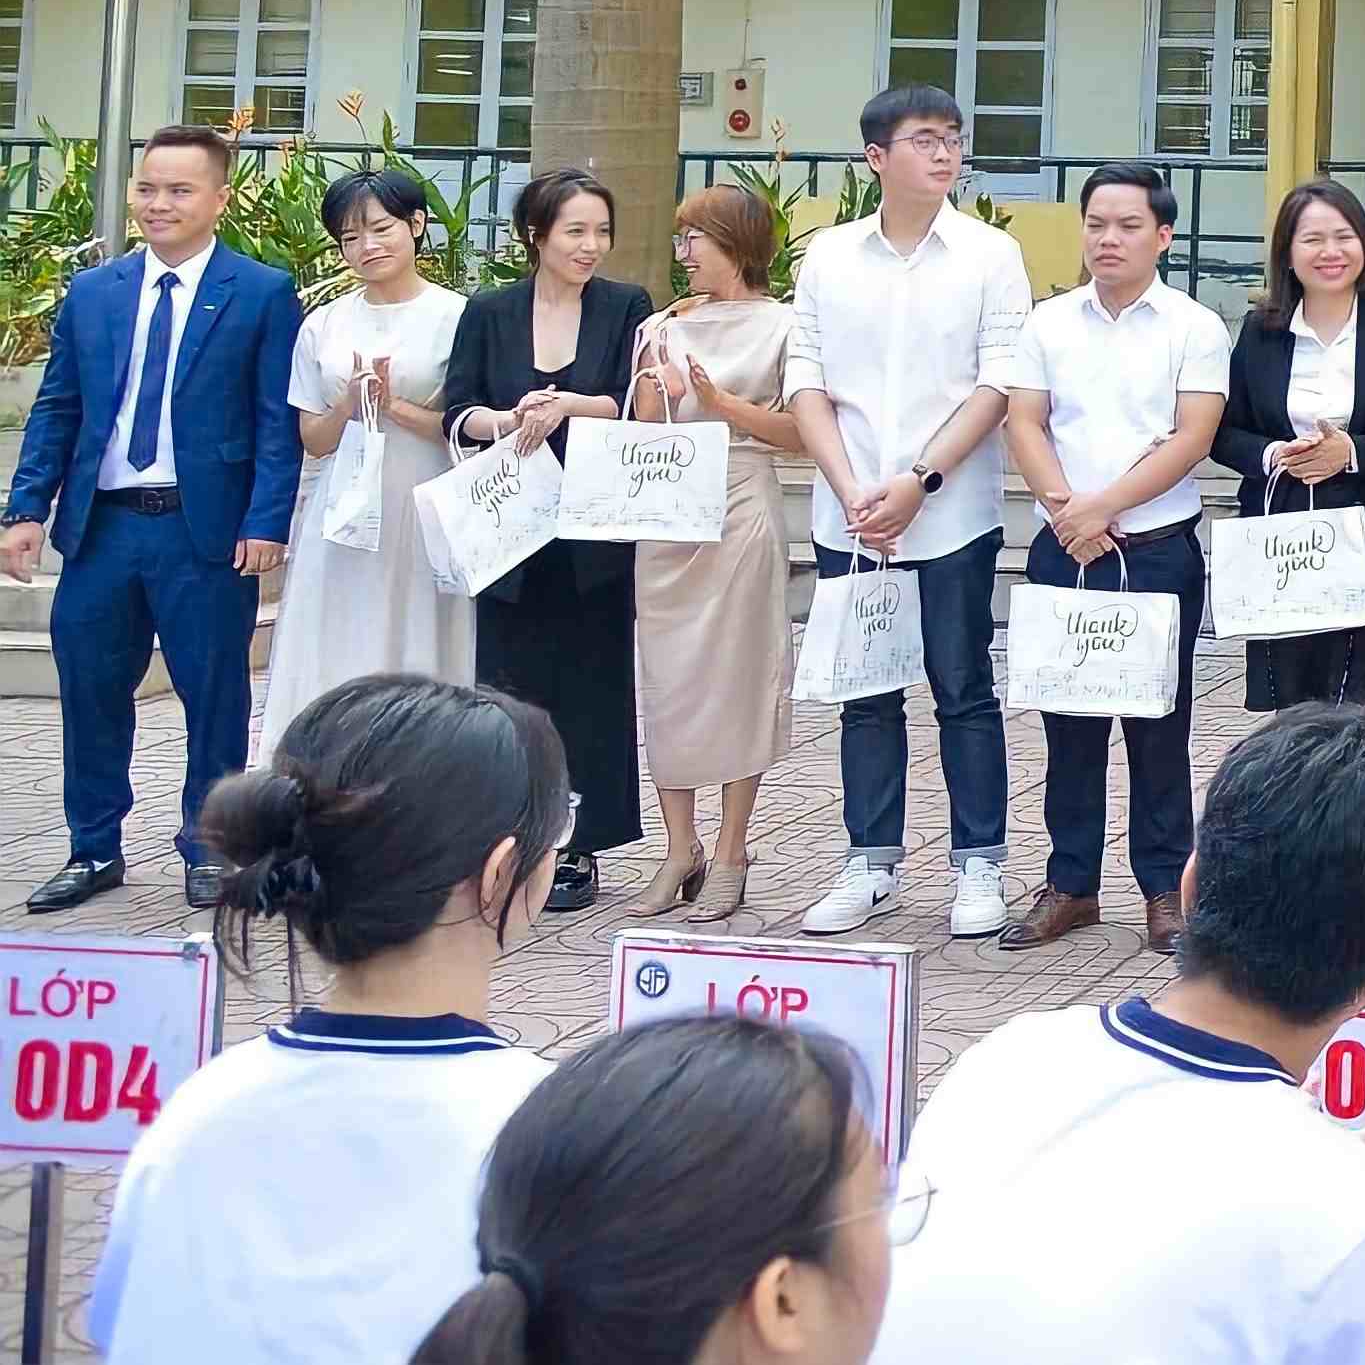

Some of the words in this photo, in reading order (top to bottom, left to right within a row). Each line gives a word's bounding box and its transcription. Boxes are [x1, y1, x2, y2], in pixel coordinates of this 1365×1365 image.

[1264, 521, 1336, 560] thank
[1066, 603, 1138, 637] thank
[9, 968, 116, 1020] LỚP
[15, 1040, 161, 1127] 0D4
